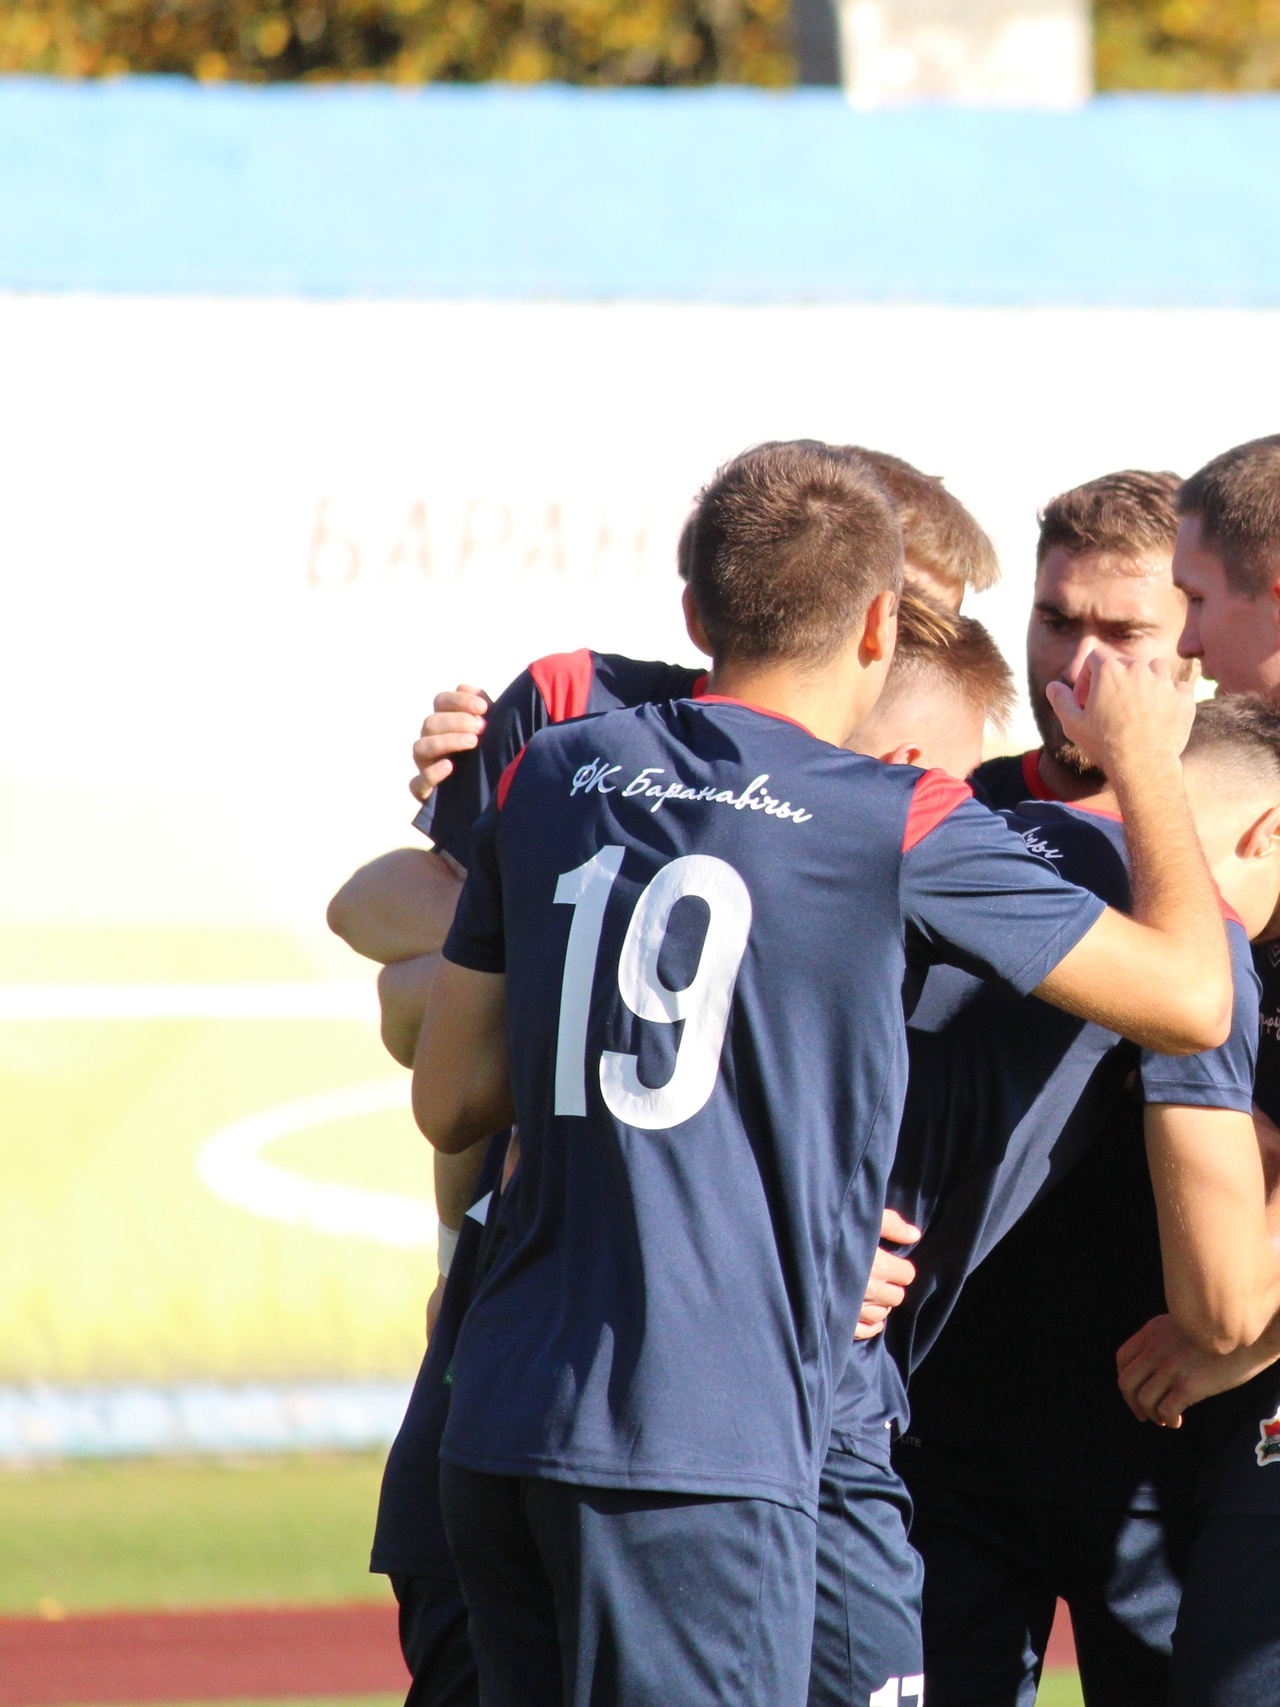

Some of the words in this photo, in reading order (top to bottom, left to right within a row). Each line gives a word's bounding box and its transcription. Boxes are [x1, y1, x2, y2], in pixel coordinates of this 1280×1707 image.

[570, 757, 622, 796] ФК
[621, 768, 813, 824] Баранавічы
[553, 845, 752, 1130] 19
